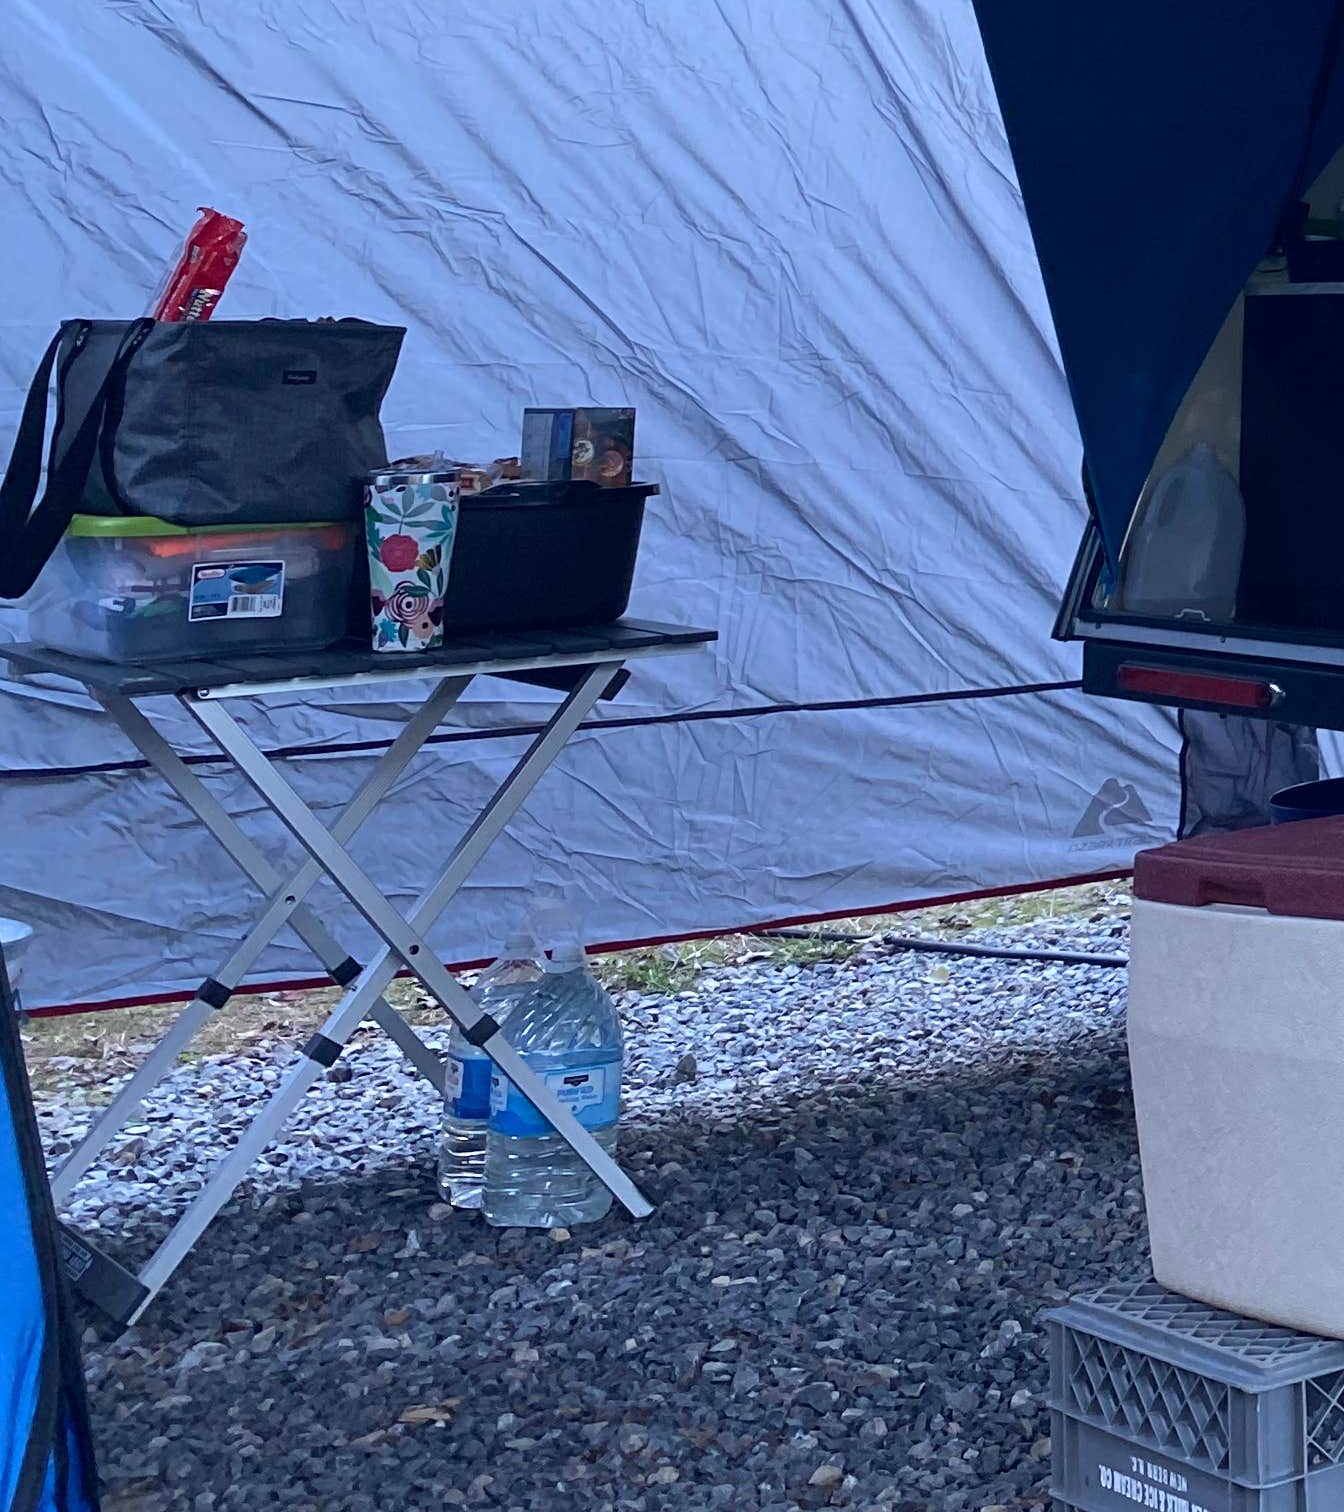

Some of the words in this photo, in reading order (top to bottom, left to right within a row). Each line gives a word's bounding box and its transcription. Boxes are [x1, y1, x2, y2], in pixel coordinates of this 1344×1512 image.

[1113, 1470, 1143, 1503] CREAM
[1146, 1461, 1169, 1486] BERN
[1169, 1470, 1188, 1493] NEW
[1144, 1483, 1159, 1510] ICE
